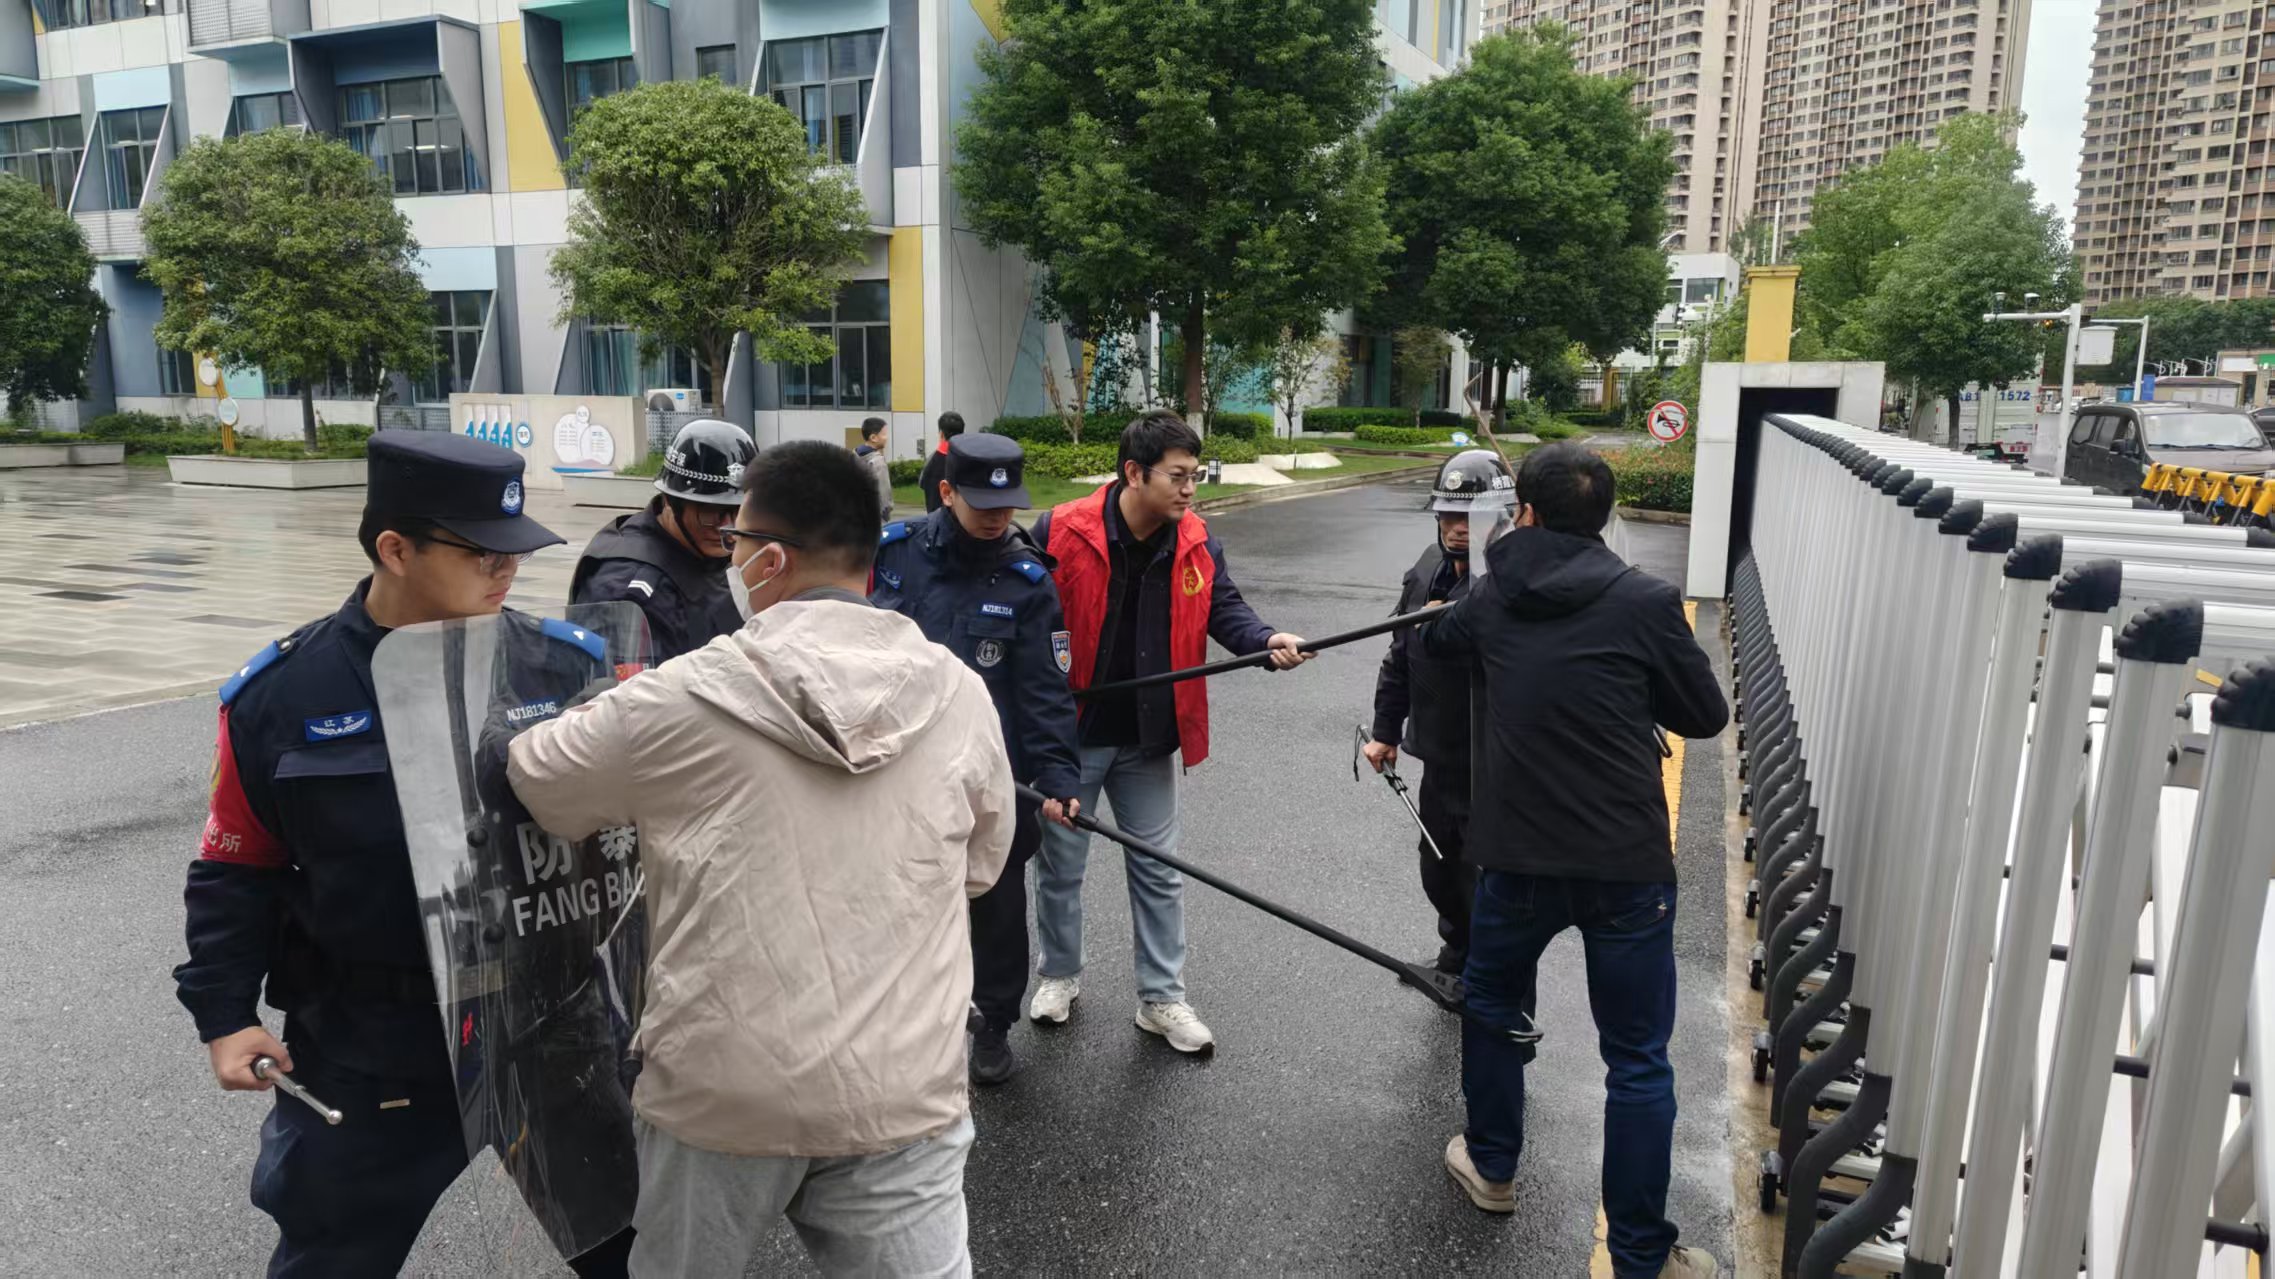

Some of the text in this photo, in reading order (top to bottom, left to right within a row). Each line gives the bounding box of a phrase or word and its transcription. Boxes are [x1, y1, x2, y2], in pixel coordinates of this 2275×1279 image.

[2000, 390, 2031, 401] 1572
[506, 701, 557, 721] NJ181346
[207, 822, 242, 853] 出所
[512, 877, 601, 937] FANG
